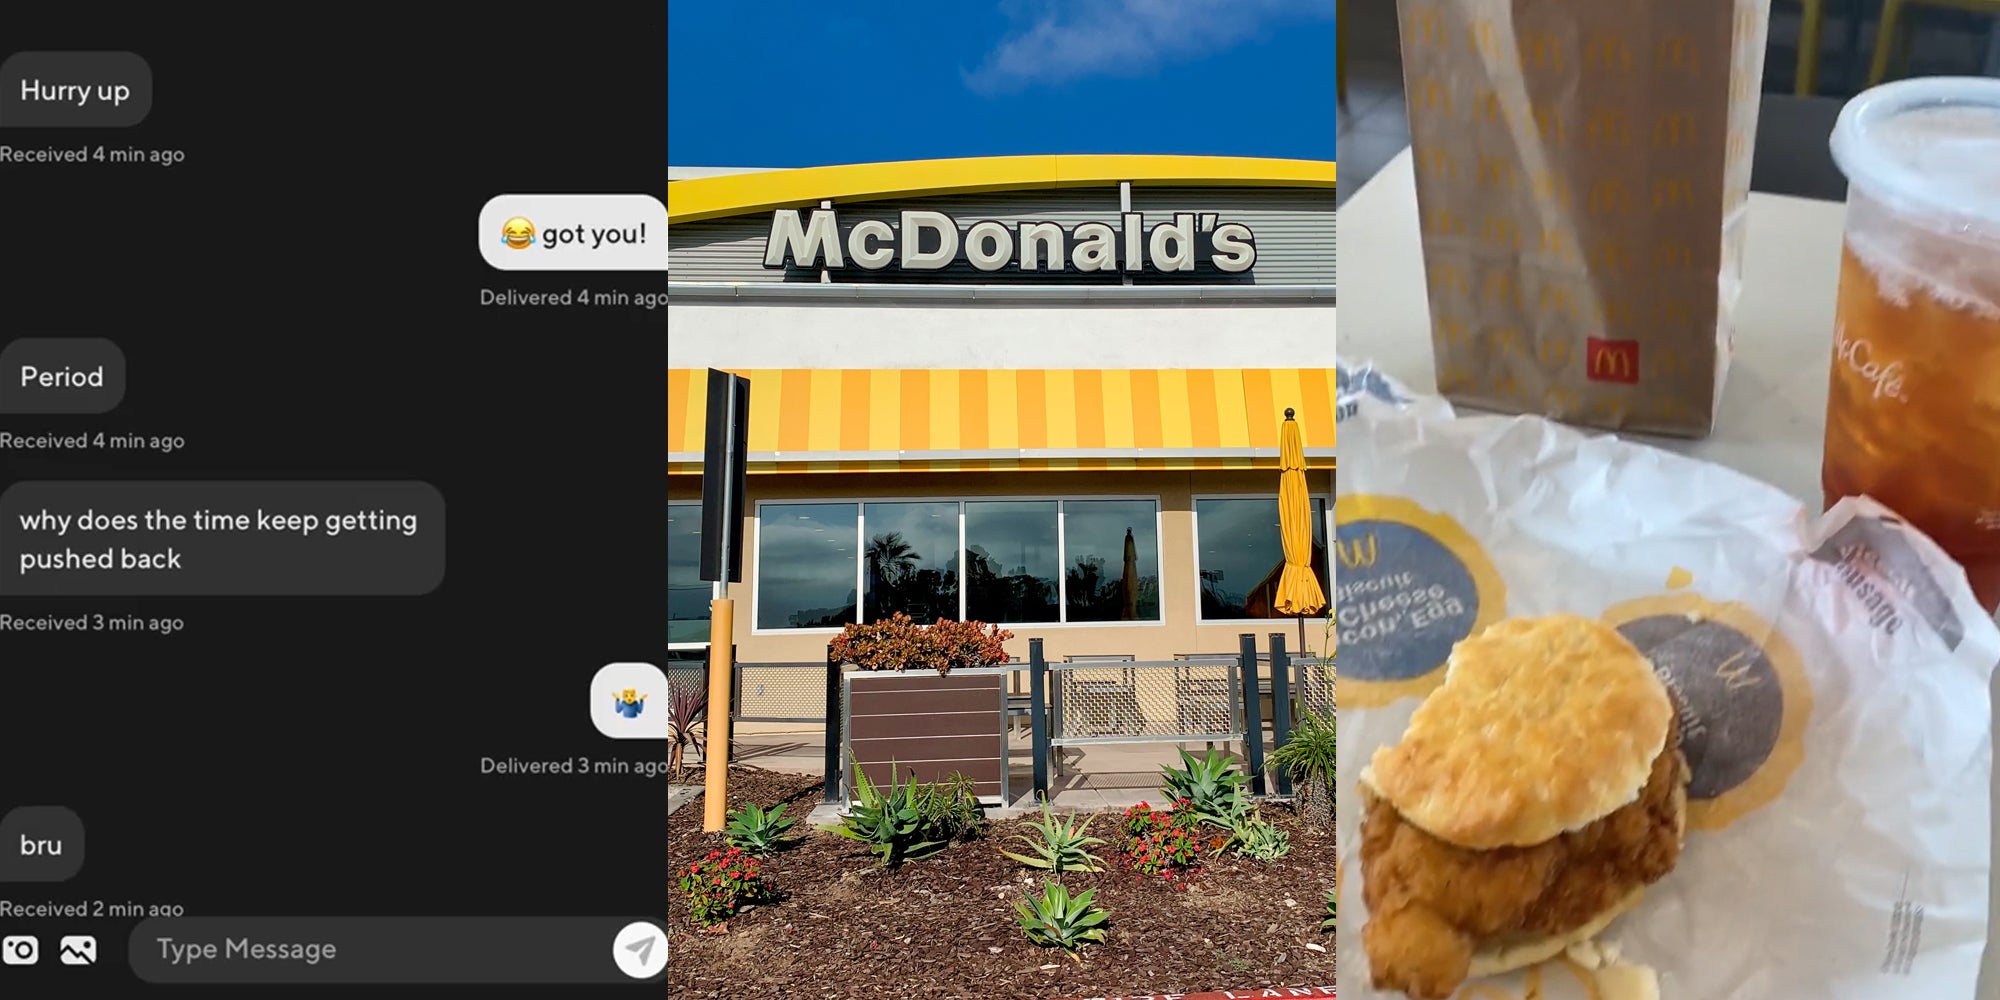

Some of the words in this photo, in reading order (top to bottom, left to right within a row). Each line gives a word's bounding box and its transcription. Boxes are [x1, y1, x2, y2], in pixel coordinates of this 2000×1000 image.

[21, 78, 92, 107] Hurry
[97, 84, 131, 107] up
[0, 145, 88, 163] Received
[92, 145, 106, 163] 4
[109, 145, 146, 162] min
[149, 149, 186, 167] ago
[542, 222, 586, 250] got
[590, 221, 646, 250] you!
[764, 209, 1257, 273] McDonald's
[480, 288, 572, 306] Delivered
[576, 288, 590, 306] 4
[594, 289, 629, 306] min
[633, 292, 668, 310] ago
[21, 365, 104, 388] Period
[0, 431, 88, 449] Received
[92, 431, 106, 449] 4
[109, 432, 146, 449] min
[149, 436, 186, 453] ago
[19, 508, 72, 537] why
[77, 508, 139, 531] does
[143, 508, 188, 531] the
[192, 509, 251, 531] time
[257, 508, 320, 537] keep
[325, 508, 417, 537] getting
[20, 546, 114, 576] pushed
[121, 546, 182, 570] back
[0, 613, 88, 631] Received
[92, 613, 105, 631] 3
[108, 614, 145, 631] min
[148, 618, 185, 635] ago
[480, 756, 573, 774] Delivered
[577, 756, 590, 774] 3
[594, 757, 629, 774] min
[633, 761, 668, 778] ago
[20, 833, 62, 856] bru
[0, 900, 88, 917] Received
[92, 900, 105, 917] 2
[108, 900, 145, 917] min
[156, 937, 218, 965] Type
[225, 937, 337, 965] Message
